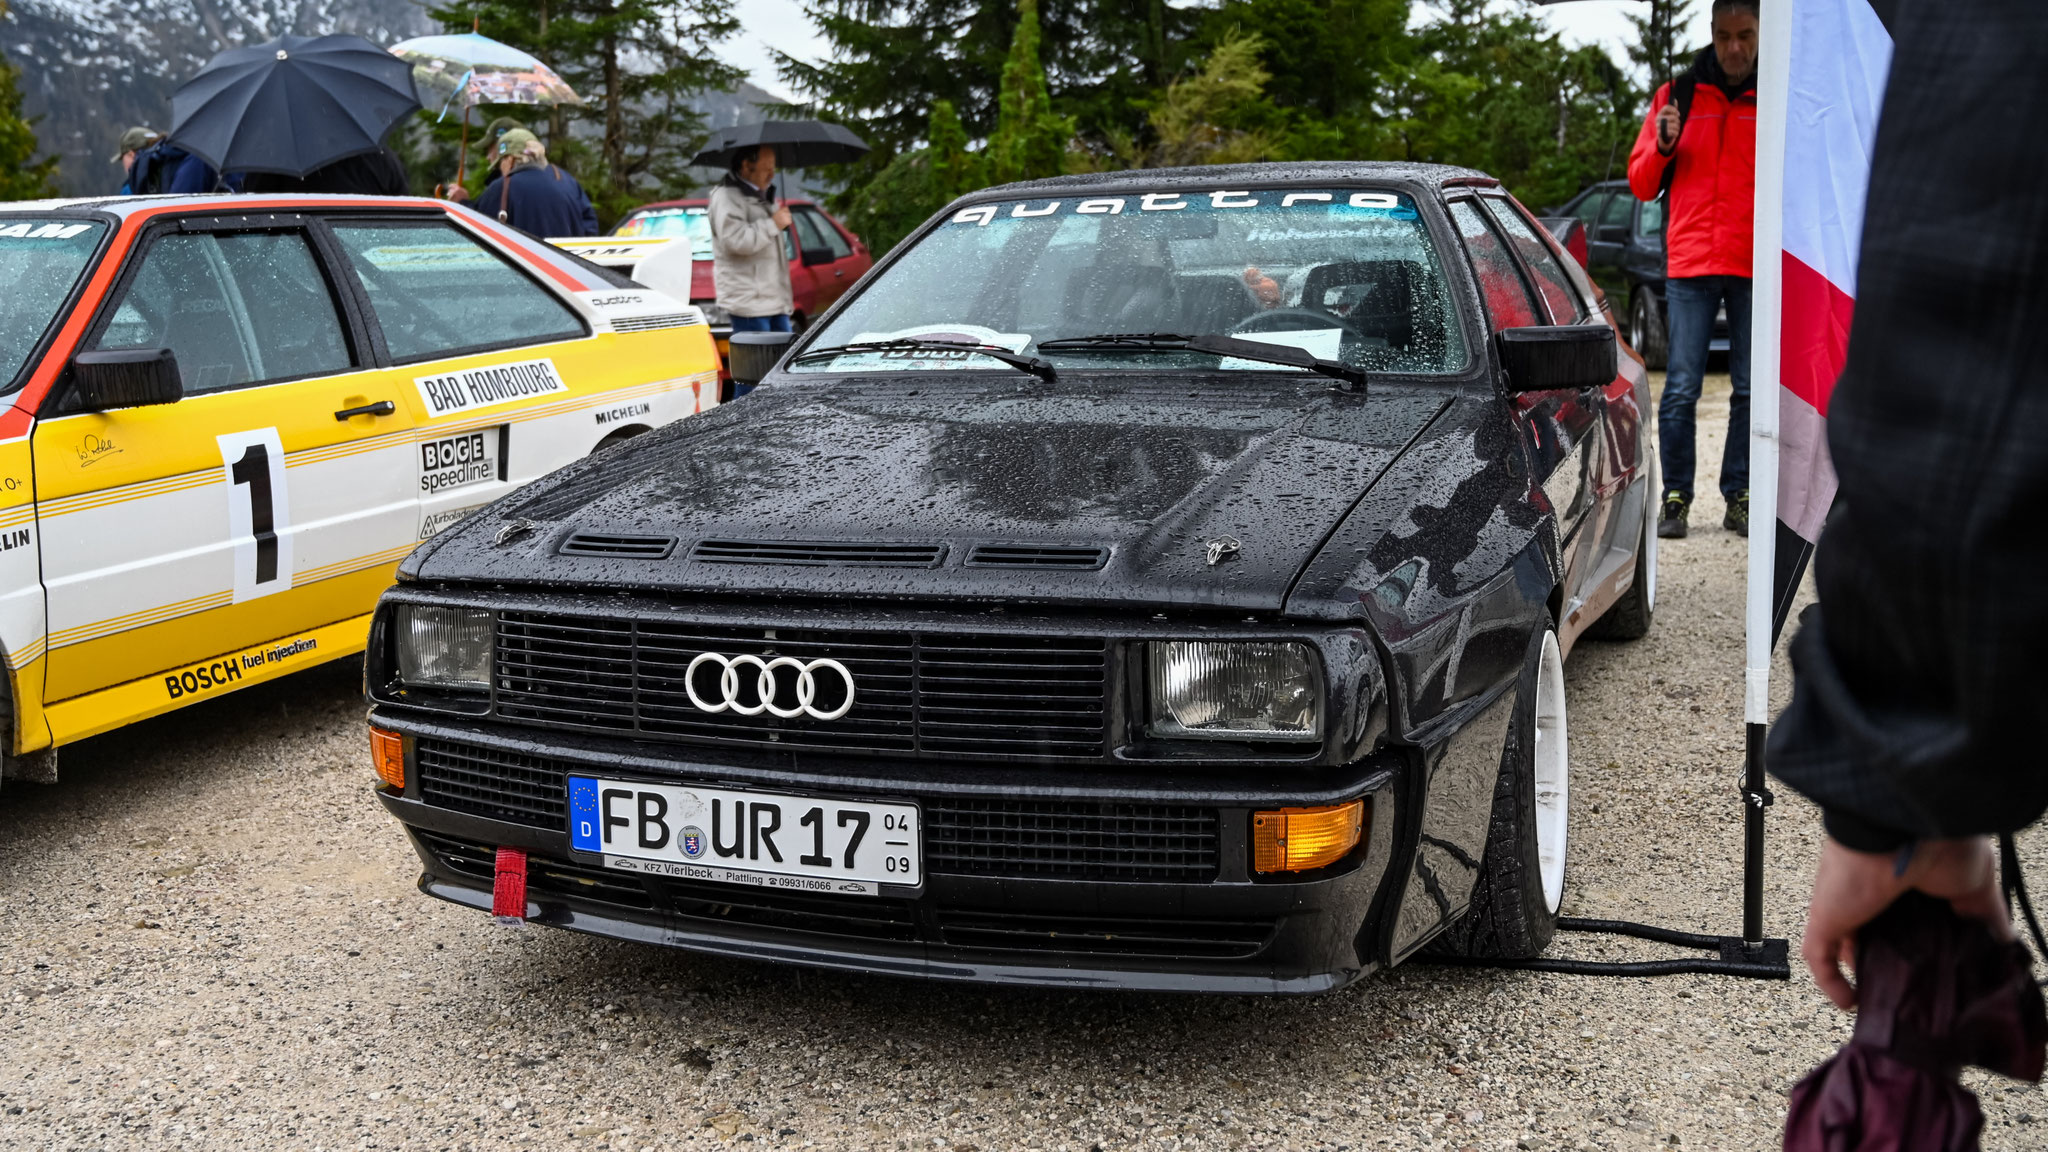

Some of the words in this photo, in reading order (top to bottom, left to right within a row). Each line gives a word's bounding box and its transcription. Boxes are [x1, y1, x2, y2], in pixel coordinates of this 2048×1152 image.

[953, 189, 1399, 227] quattro
[0, 224, 92, 238] AM
[592, 296, 643, 308] quattro
[424, 380, 467, 412] BAD
[463, 362, 558, 404] HOMBOURG
[595, 403, 651, 425] MICHELIN
[424, 435, 483, 470] BOGE
[421, 461, 489, 494] speedline
[232, 443, 278, 585] 1
[0, 529, 30, 552] LIN
[165, 658, 242, 699] BOSCH
[242, 651, 265, 669] fuel
[267, 638, 317, 663] injection
[581, 821, 592, 838] D
[602, 787, 671, 850] FB
[712, 797, 784, 863] UR
[799, 806, 871, 870] 17
[884, 813, 908, 831] 04
[644, 862, 662, 873] KFZ
[664, 863, 713, 879] Vierlbeck
[726, 871, 763, 885] Plattling
[886, 856, 910, 873] 09
